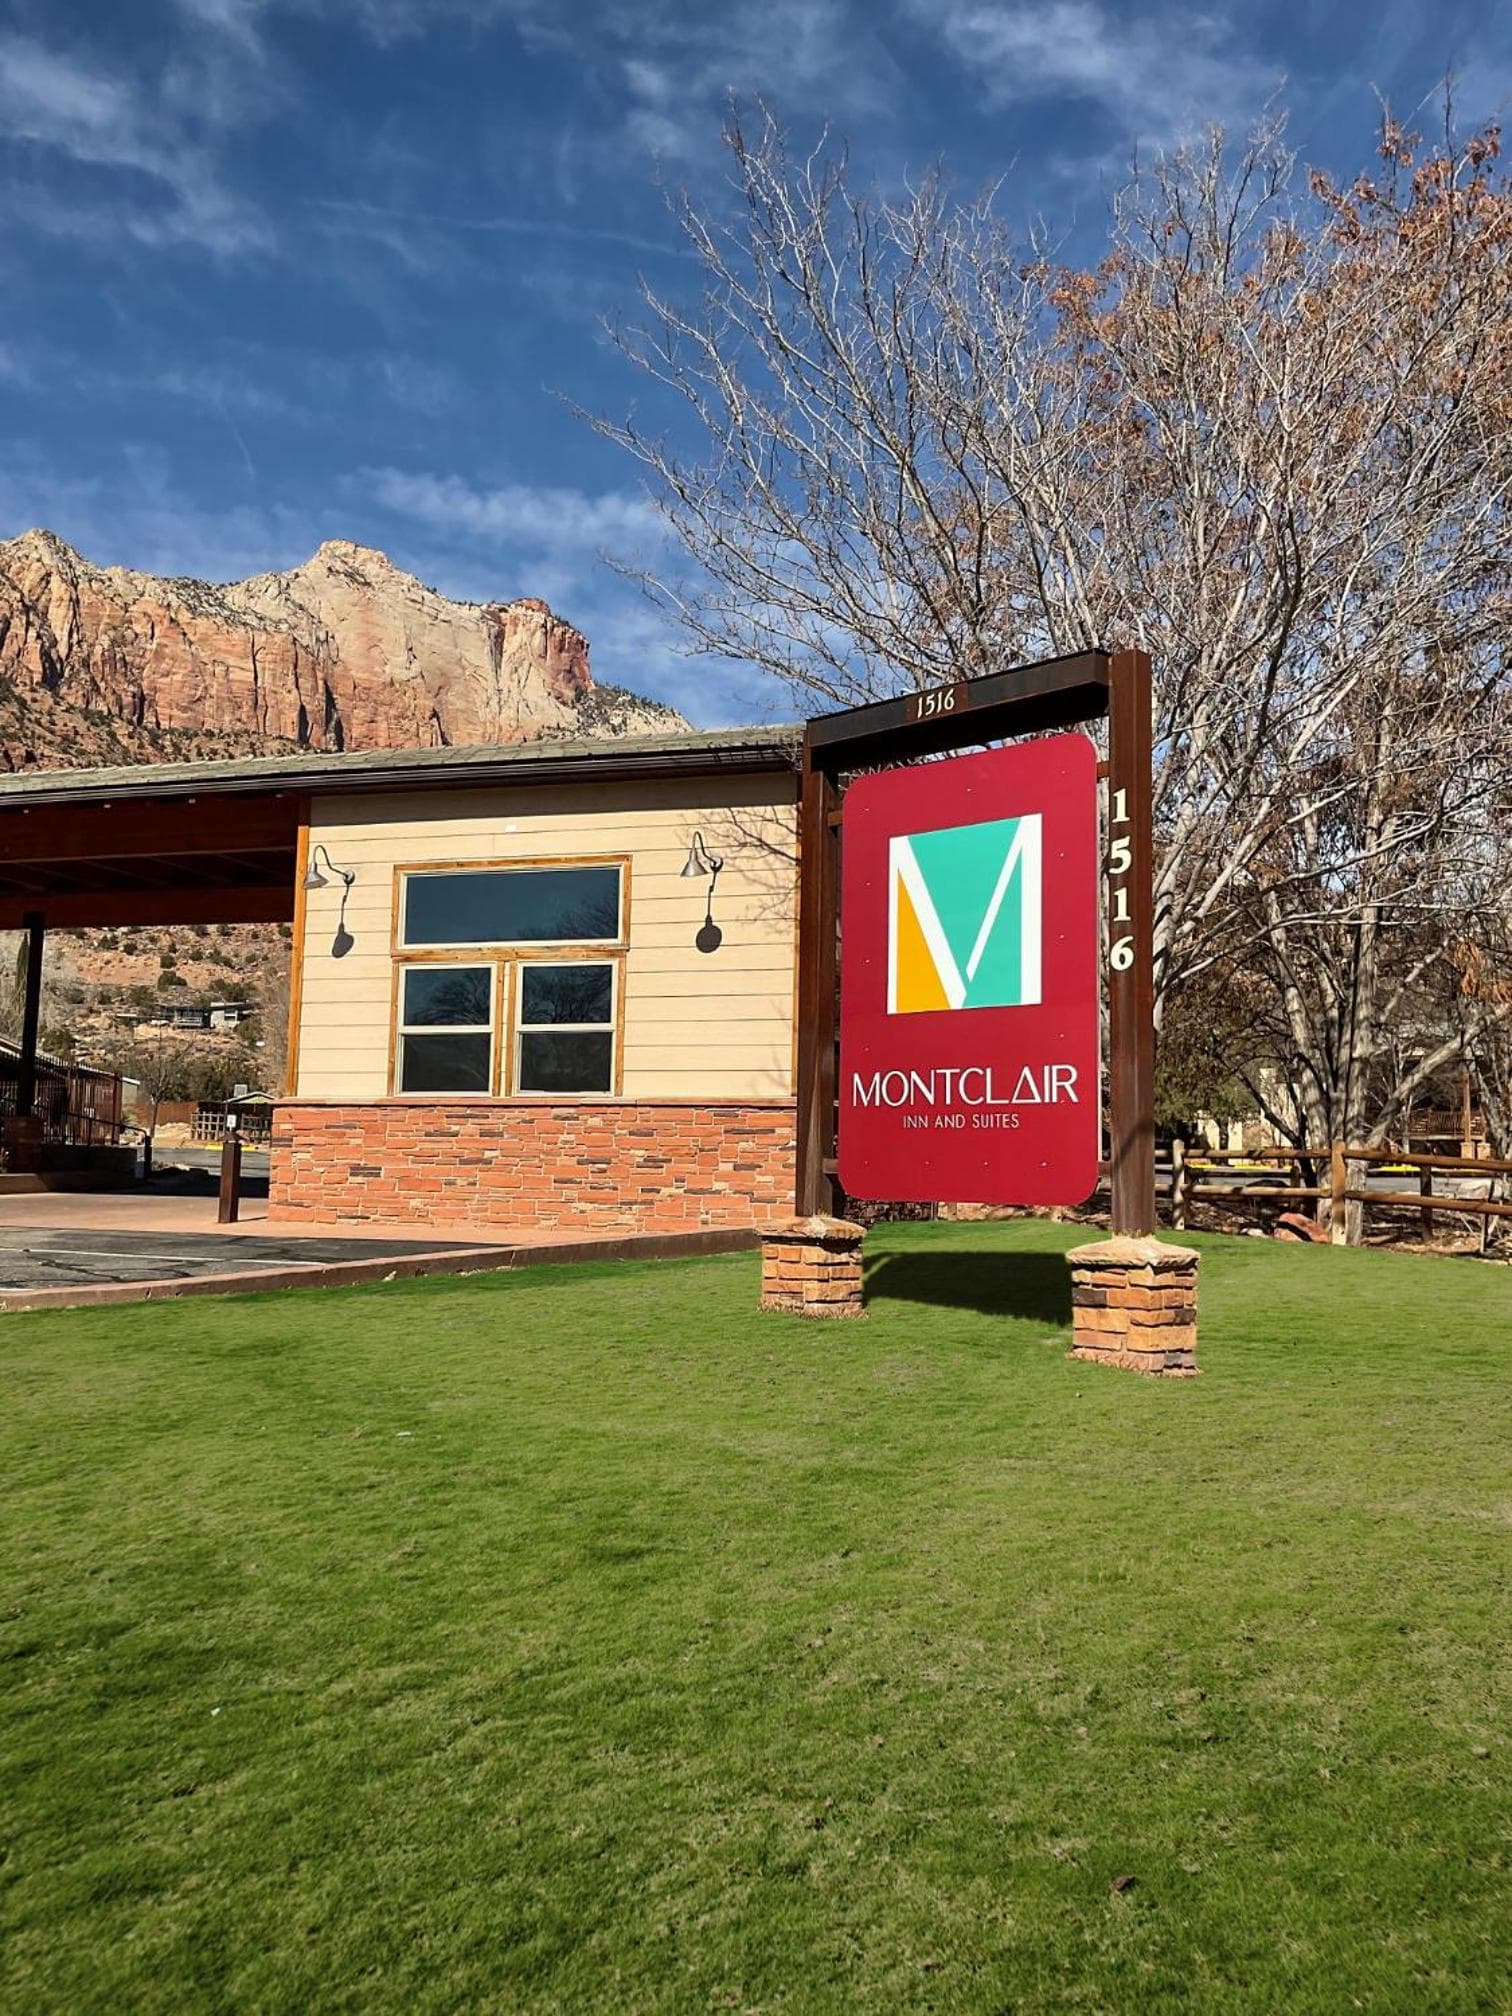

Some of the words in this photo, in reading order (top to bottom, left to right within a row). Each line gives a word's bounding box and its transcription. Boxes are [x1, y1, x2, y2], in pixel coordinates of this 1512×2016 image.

[917, 688, 955, 719] 1516
[1109, 788, 1134, 971] 1516
[853, 1064, 1079, 1107] MONTCLAIR
[903, 1115, 929, 1128] INN
[934, 1114, 966, 1129] AND
[972, 1113, 1020, 1129] SUITES
